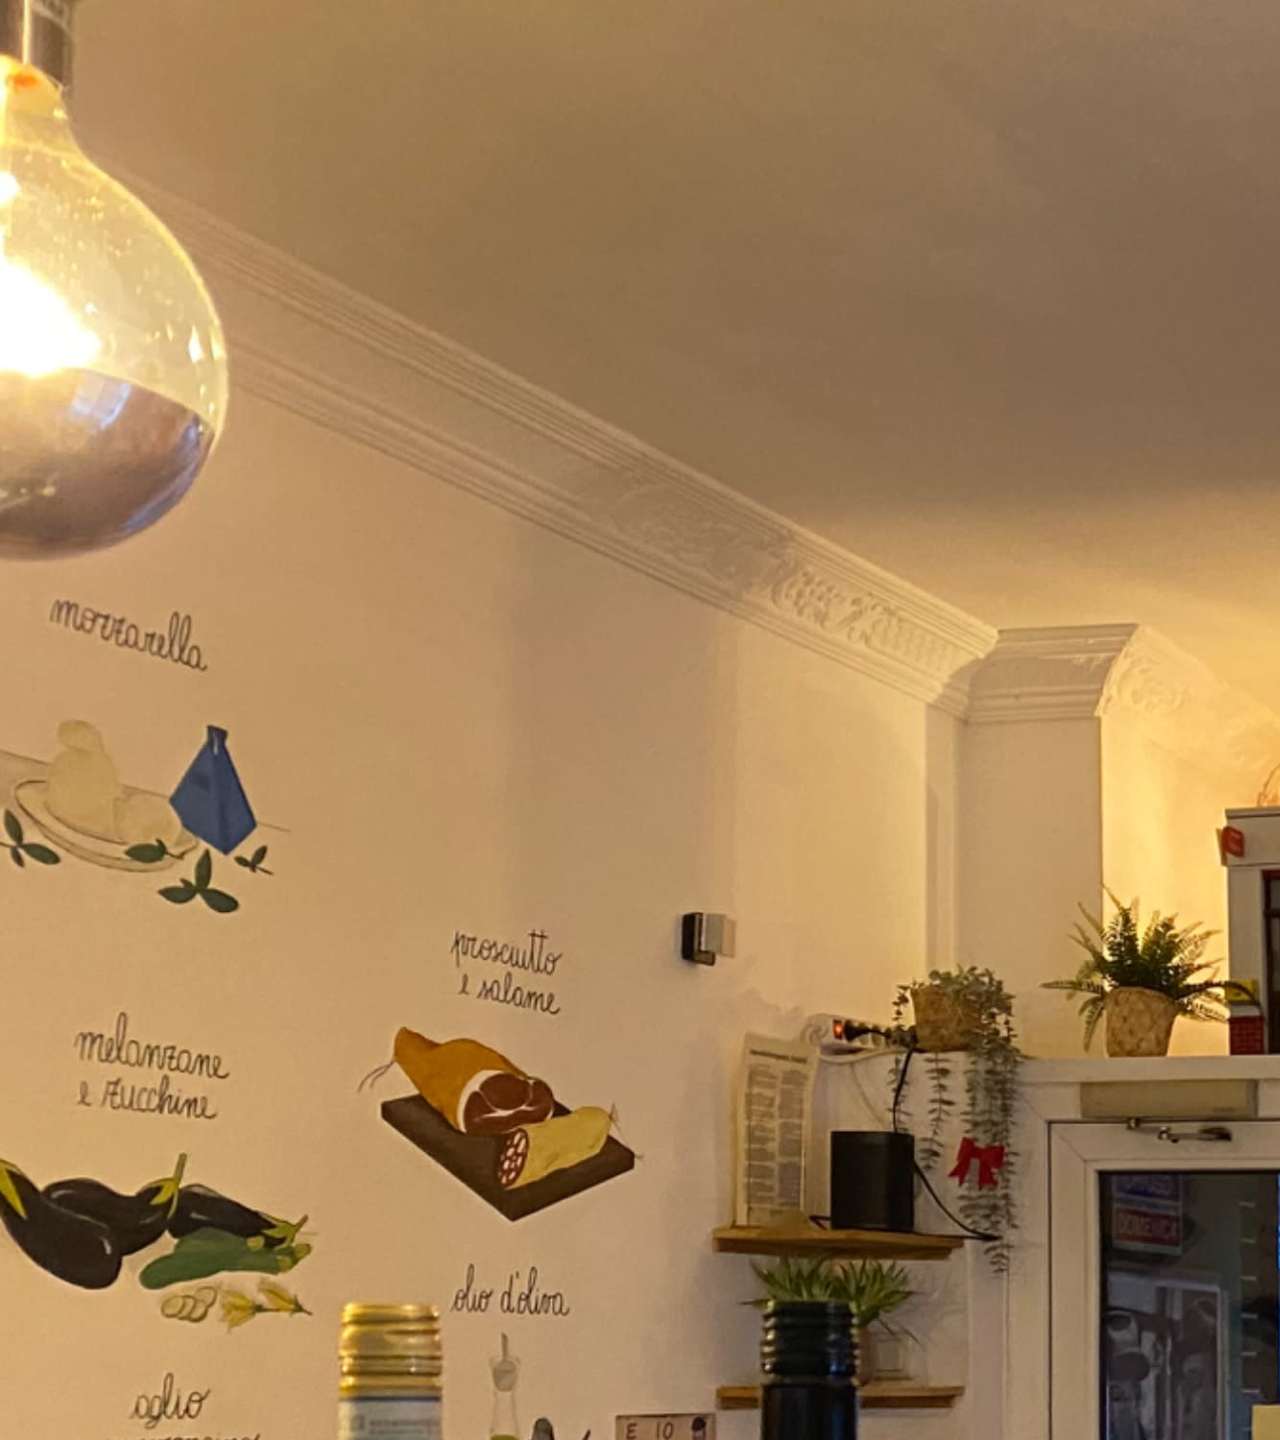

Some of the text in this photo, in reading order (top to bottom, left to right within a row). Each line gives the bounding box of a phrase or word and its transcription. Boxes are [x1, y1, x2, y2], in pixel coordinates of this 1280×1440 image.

[476, 971, 561, 1015] salame
[74, 1011, 230, 1079] melanzane
[77, 1074, 217, 1120] e zucchine
[450, 1263, 571, 1316] olio d'oliva
[130, 1372, 212, 1430] aglio
[625, 1422, 638, 1440] E
